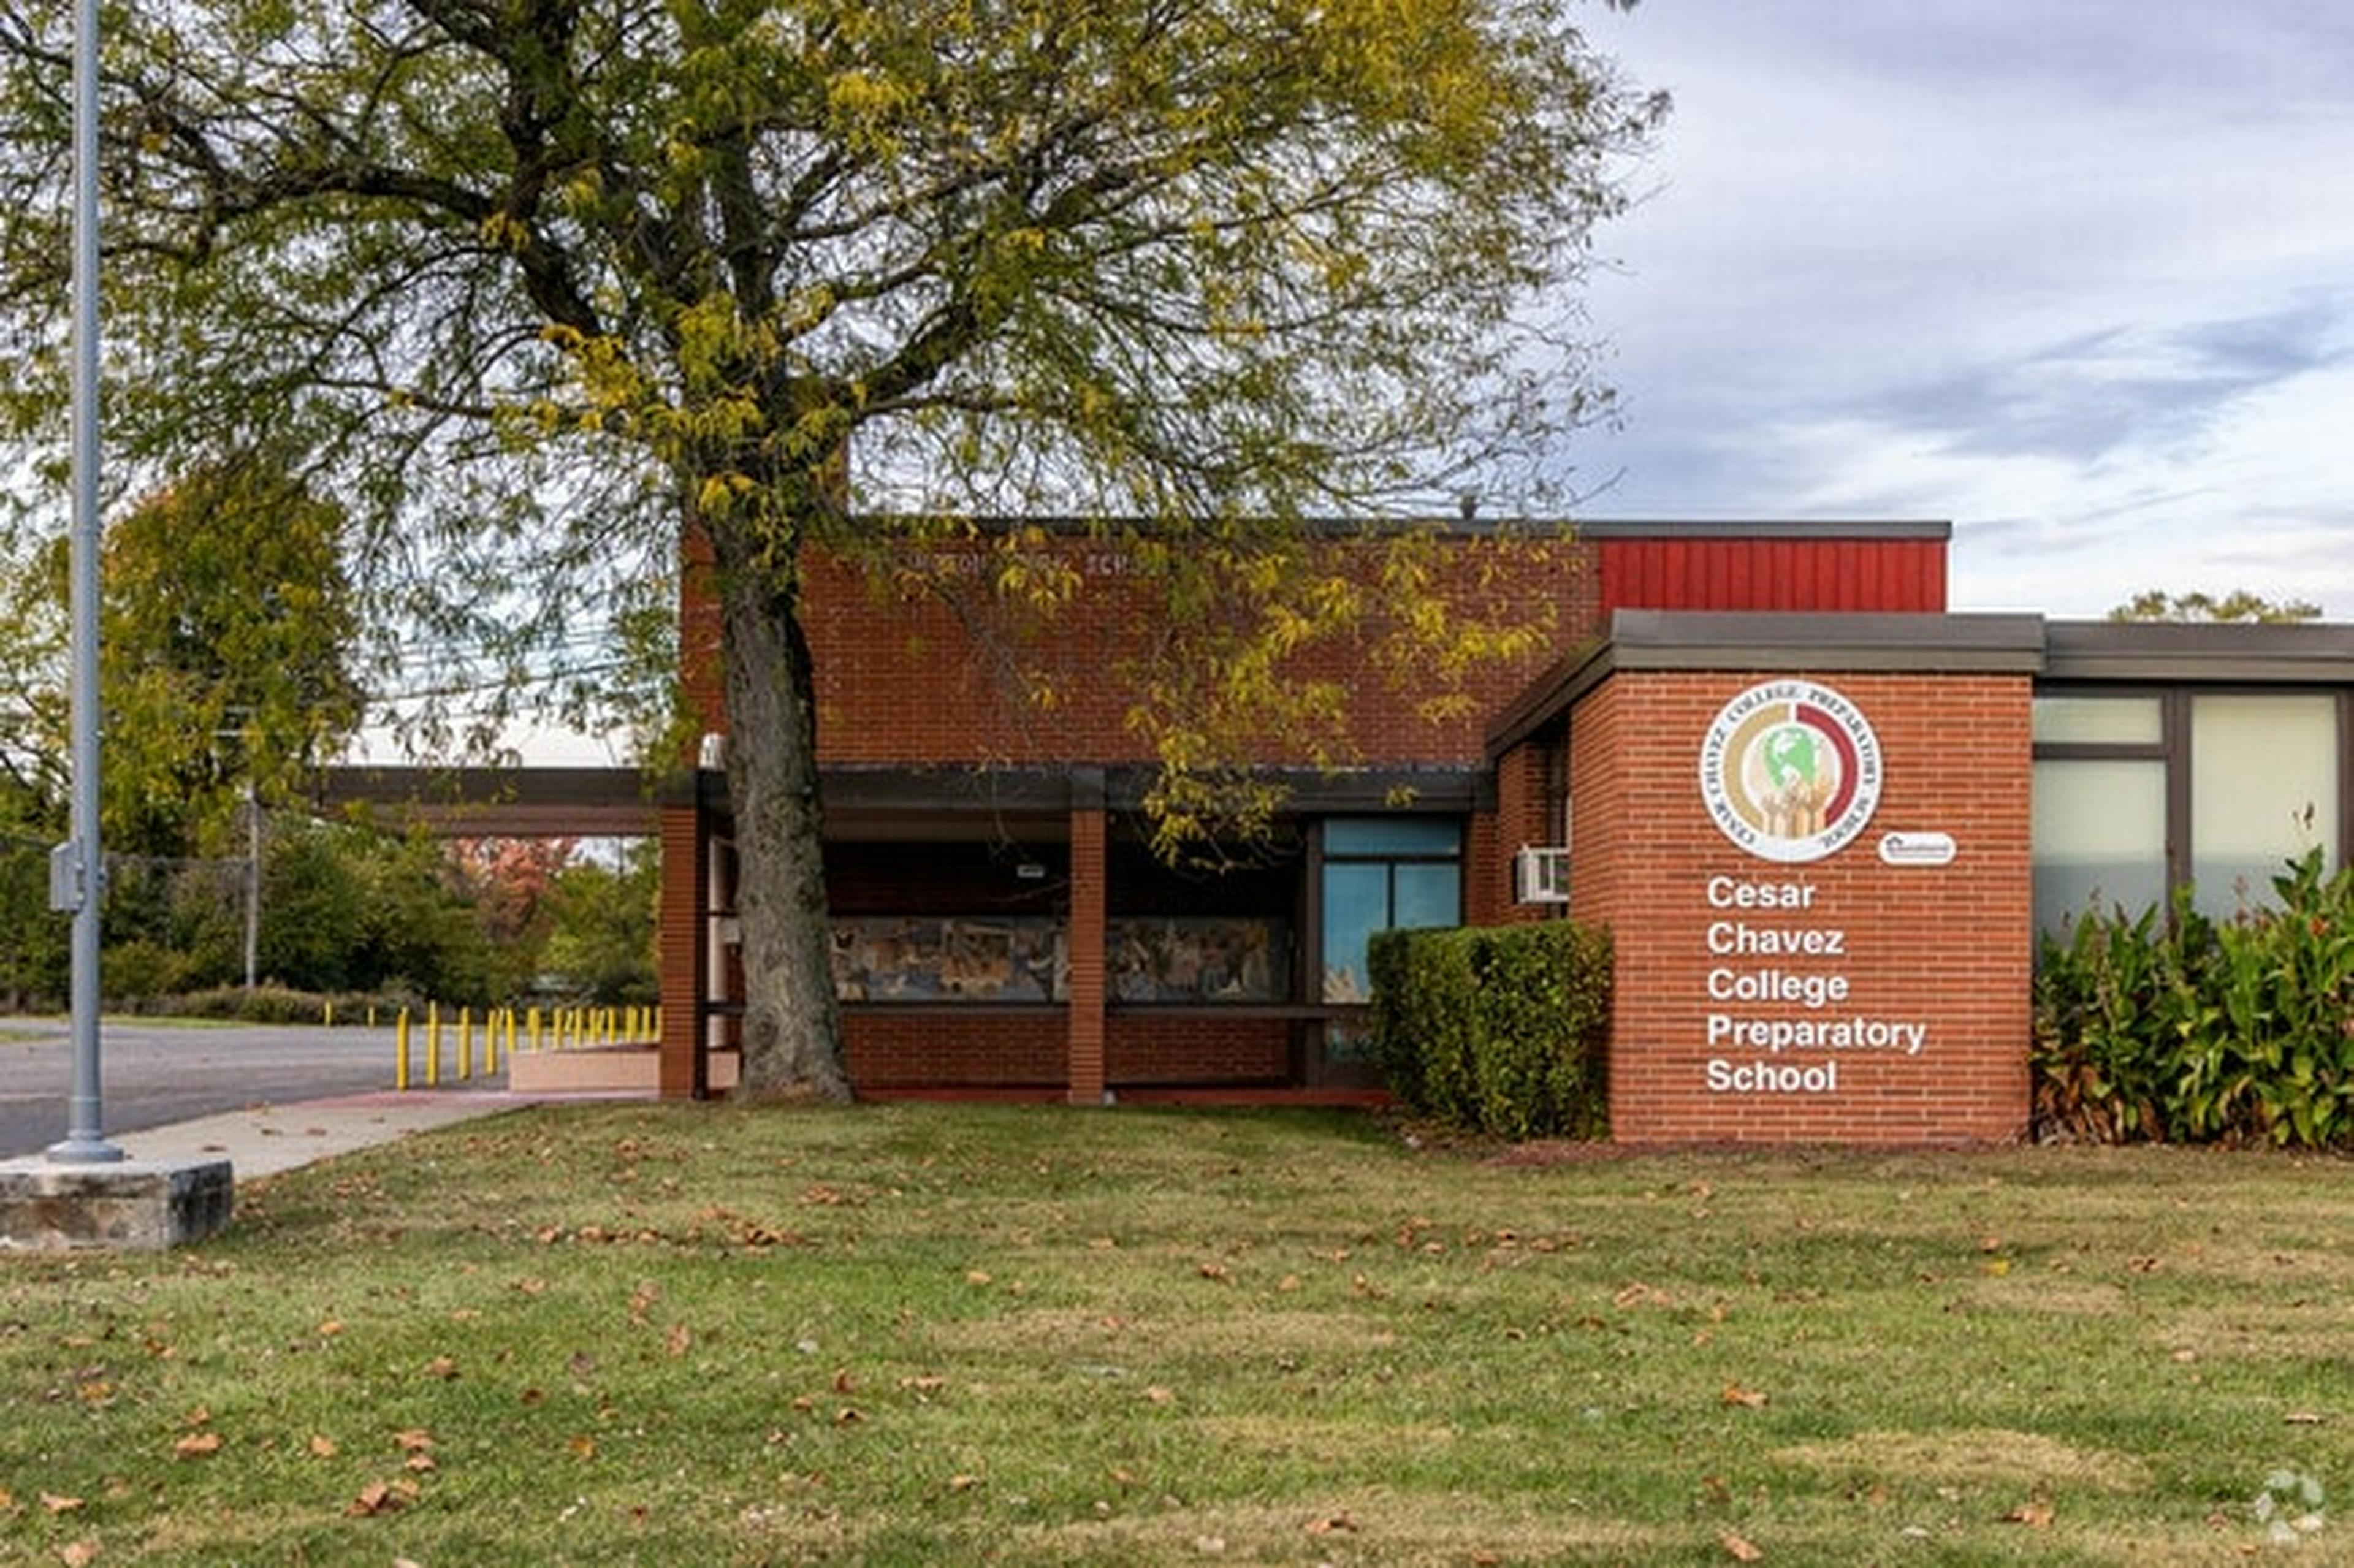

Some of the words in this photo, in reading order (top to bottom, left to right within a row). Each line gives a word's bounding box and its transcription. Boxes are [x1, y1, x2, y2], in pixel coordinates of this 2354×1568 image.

[1708, 877, 1815, 907] Cesar
[1708, 922, 1843, 954] Chavez
[1708, 969, 1848, 1007] College
[1708, 1014, 1925, 1054] Preparatory
[1707, 1059, 1835, 1090] School
